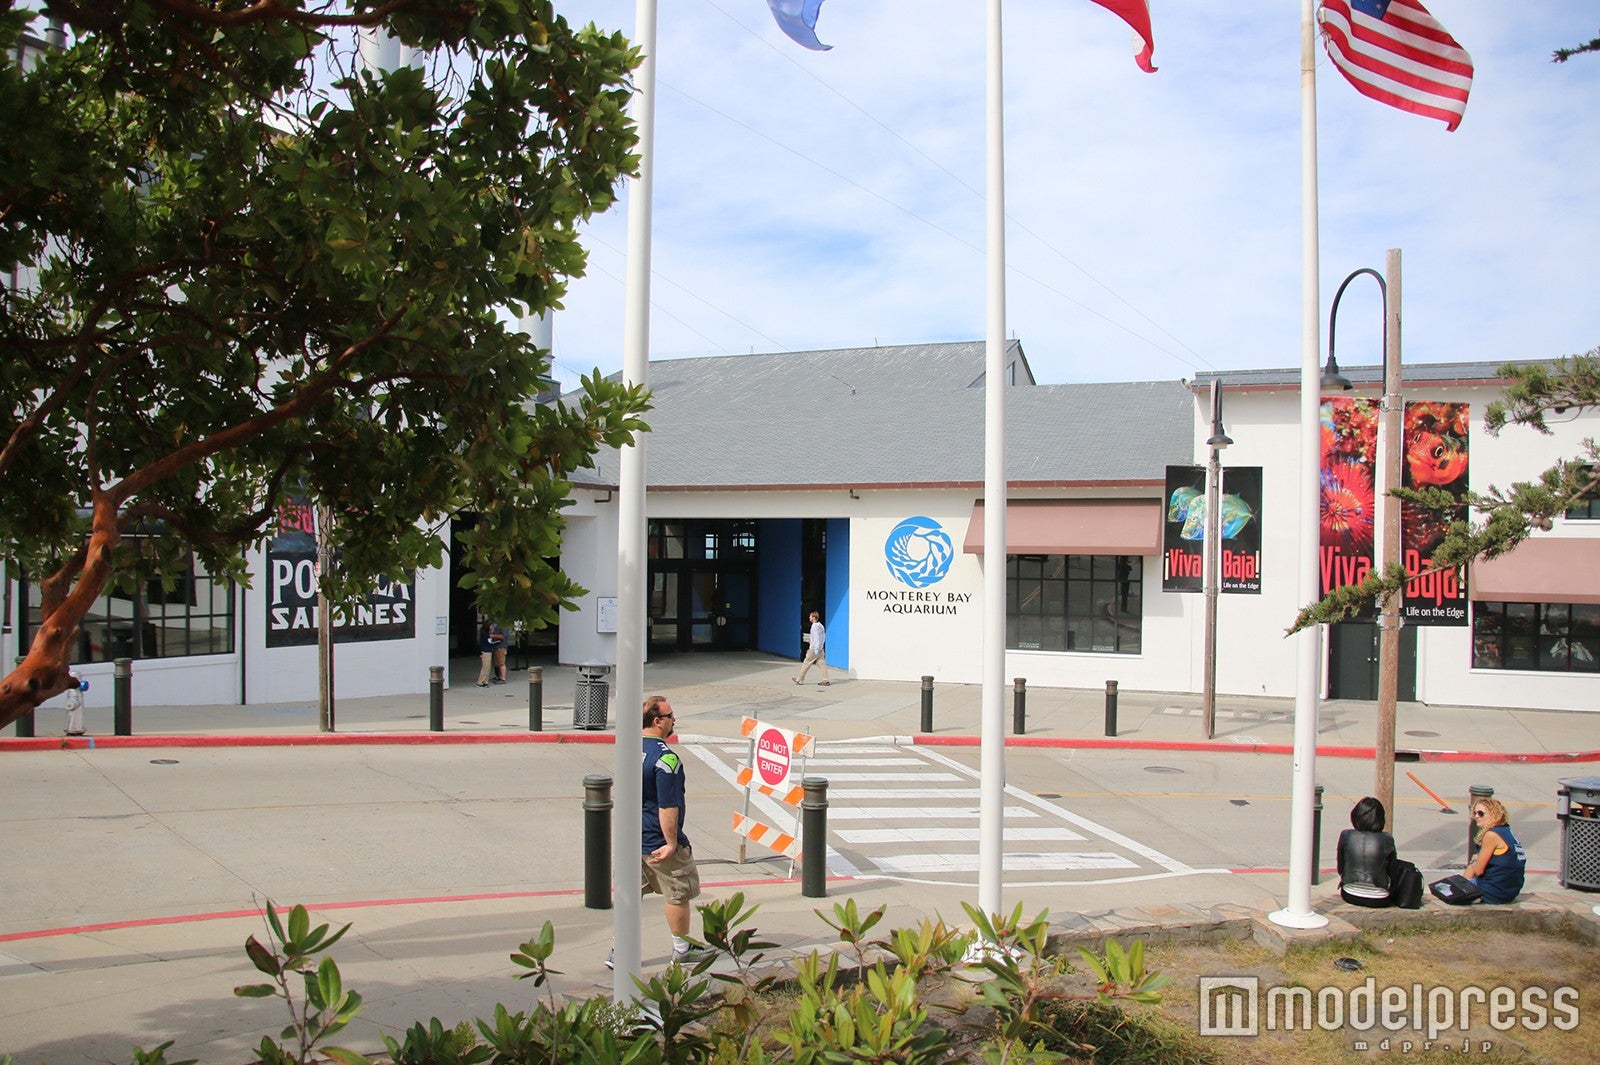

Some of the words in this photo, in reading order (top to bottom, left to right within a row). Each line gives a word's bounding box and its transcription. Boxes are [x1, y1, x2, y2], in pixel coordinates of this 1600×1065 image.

[1164, 548, 1202, 581] ¡Viva
[1222, 549, 1260, 583] Baja!
[1247, 582, 1259, 590] Edge
[866, 590, 942, 602] MONTEREY
[947, 592, 973, 603] BAY
[883, 603, 957, 615] AQUARIUM
[1406, 606, 1420, 617] Life
[1420, 608, 1431, 617] on
[1432, 606, 1445, 617] the
[1446, 607, 1465, 619] Edge
[760, 738, 771, 750] DO
[772, 741, 787, 755] NOT
[760, 760, 783, 776] ENTER
